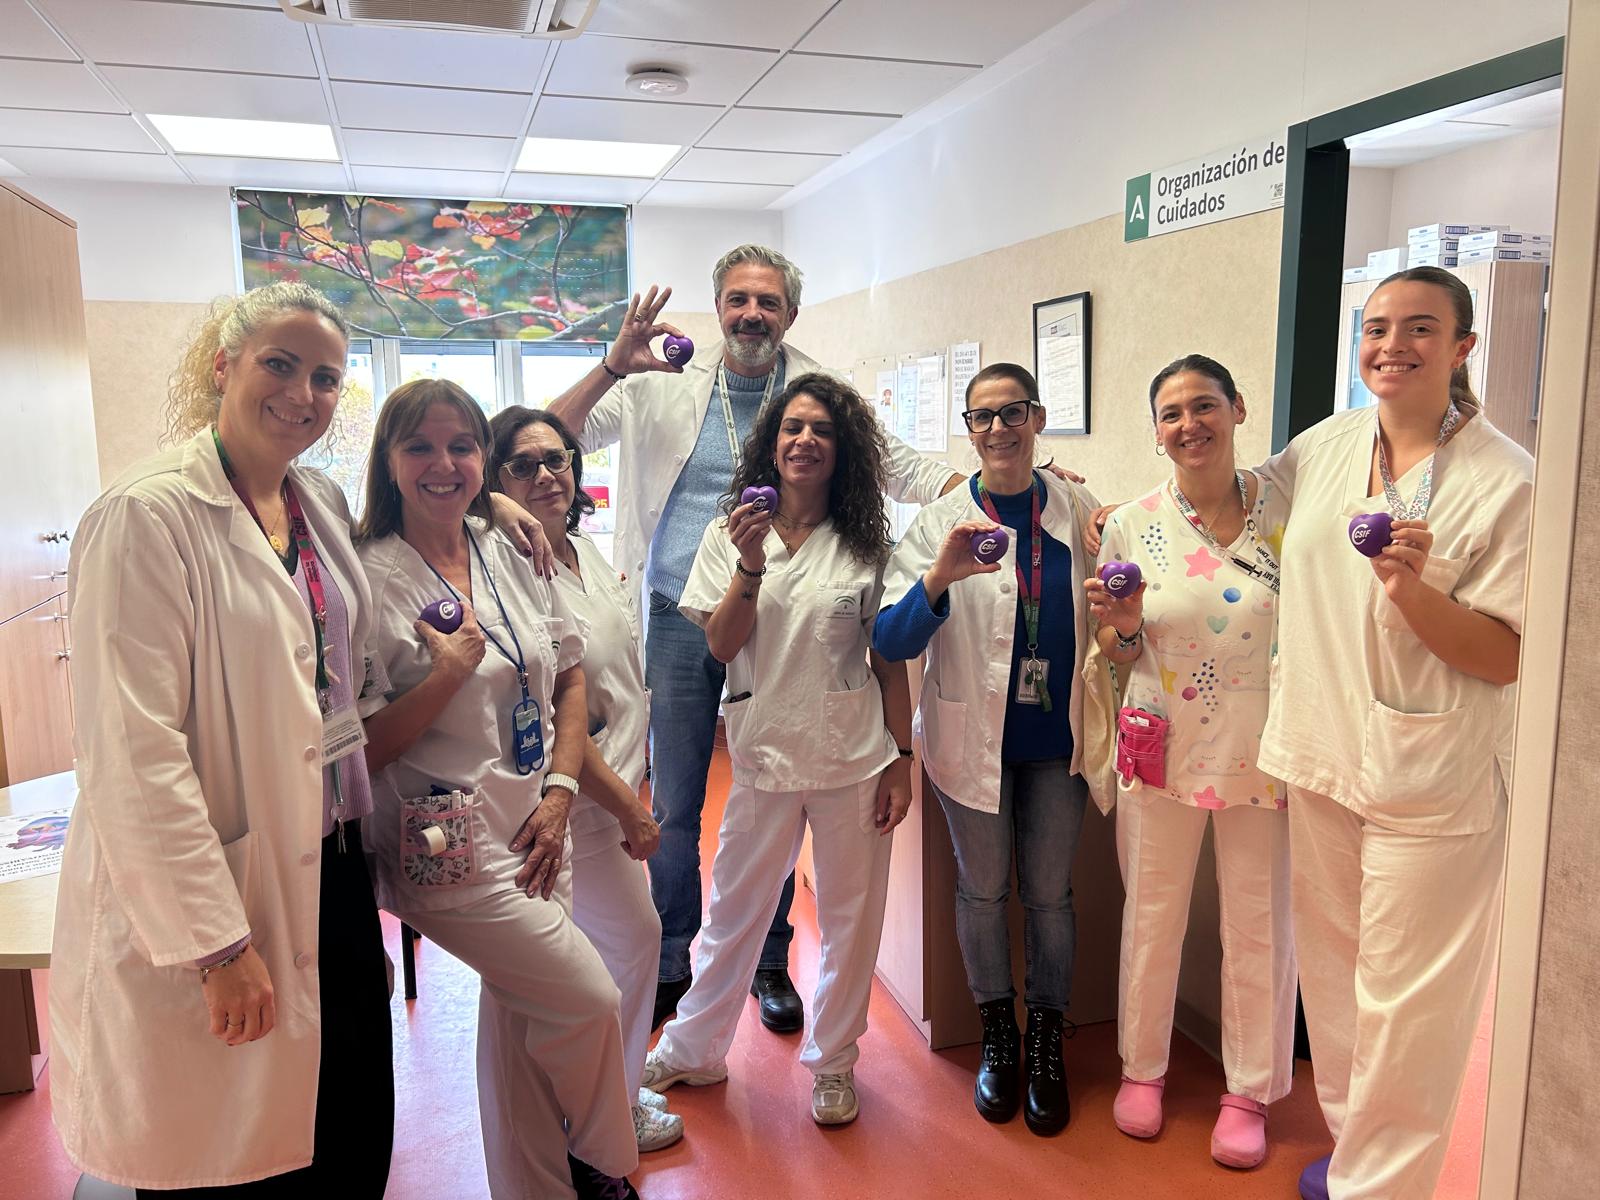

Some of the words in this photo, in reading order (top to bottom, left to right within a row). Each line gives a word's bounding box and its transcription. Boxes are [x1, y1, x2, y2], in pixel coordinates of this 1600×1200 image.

[1157, 147, 1258, 199] Organización
[1263, 141, 1285, 168] de
[1157, 192, 1225, 225] Cuidados
[1256, 546, 1269, 558] DANCE
[1269, 561, 1279, 570] OUT
